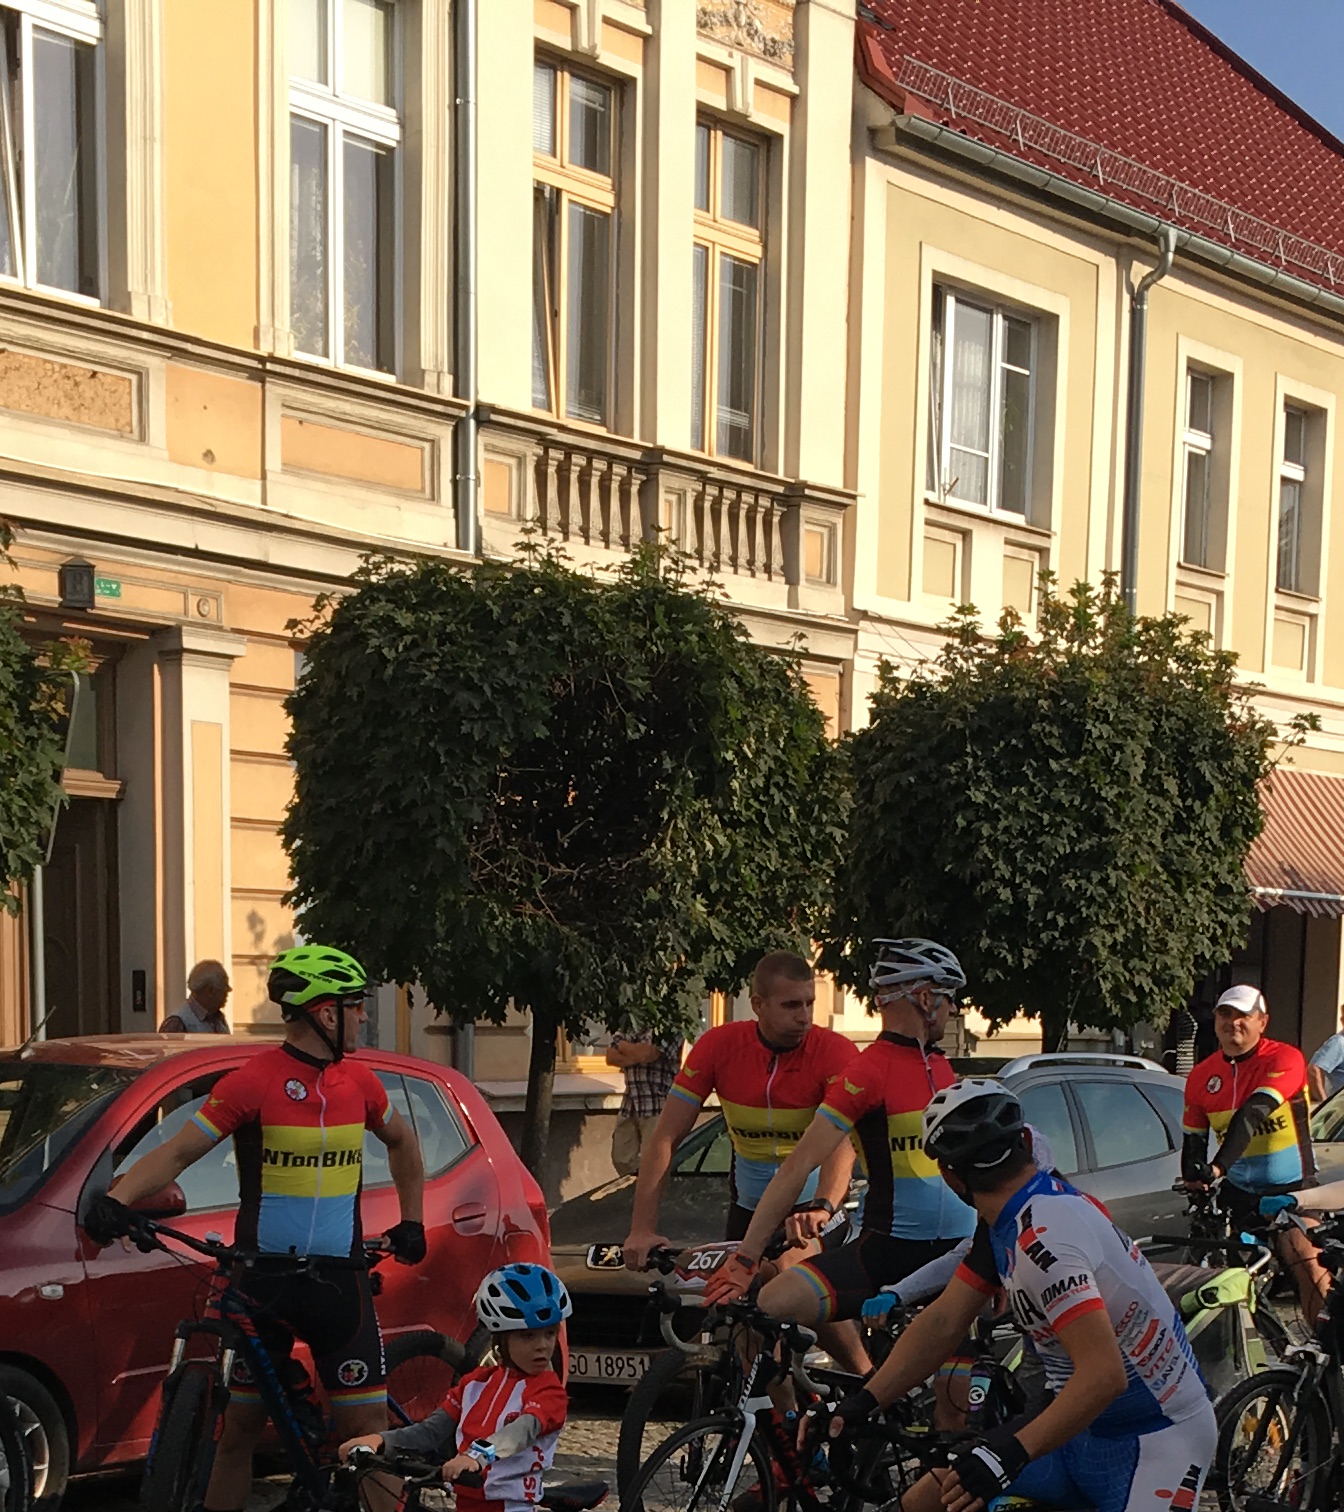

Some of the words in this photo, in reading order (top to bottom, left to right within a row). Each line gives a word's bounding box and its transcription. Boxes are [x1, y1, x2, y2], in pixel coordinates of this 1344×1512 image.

[688, 1250, 726, 1270] 267
[596, 1355, 645, 1378] 18951
[1144, 1337, 1174, 1379] VITO
